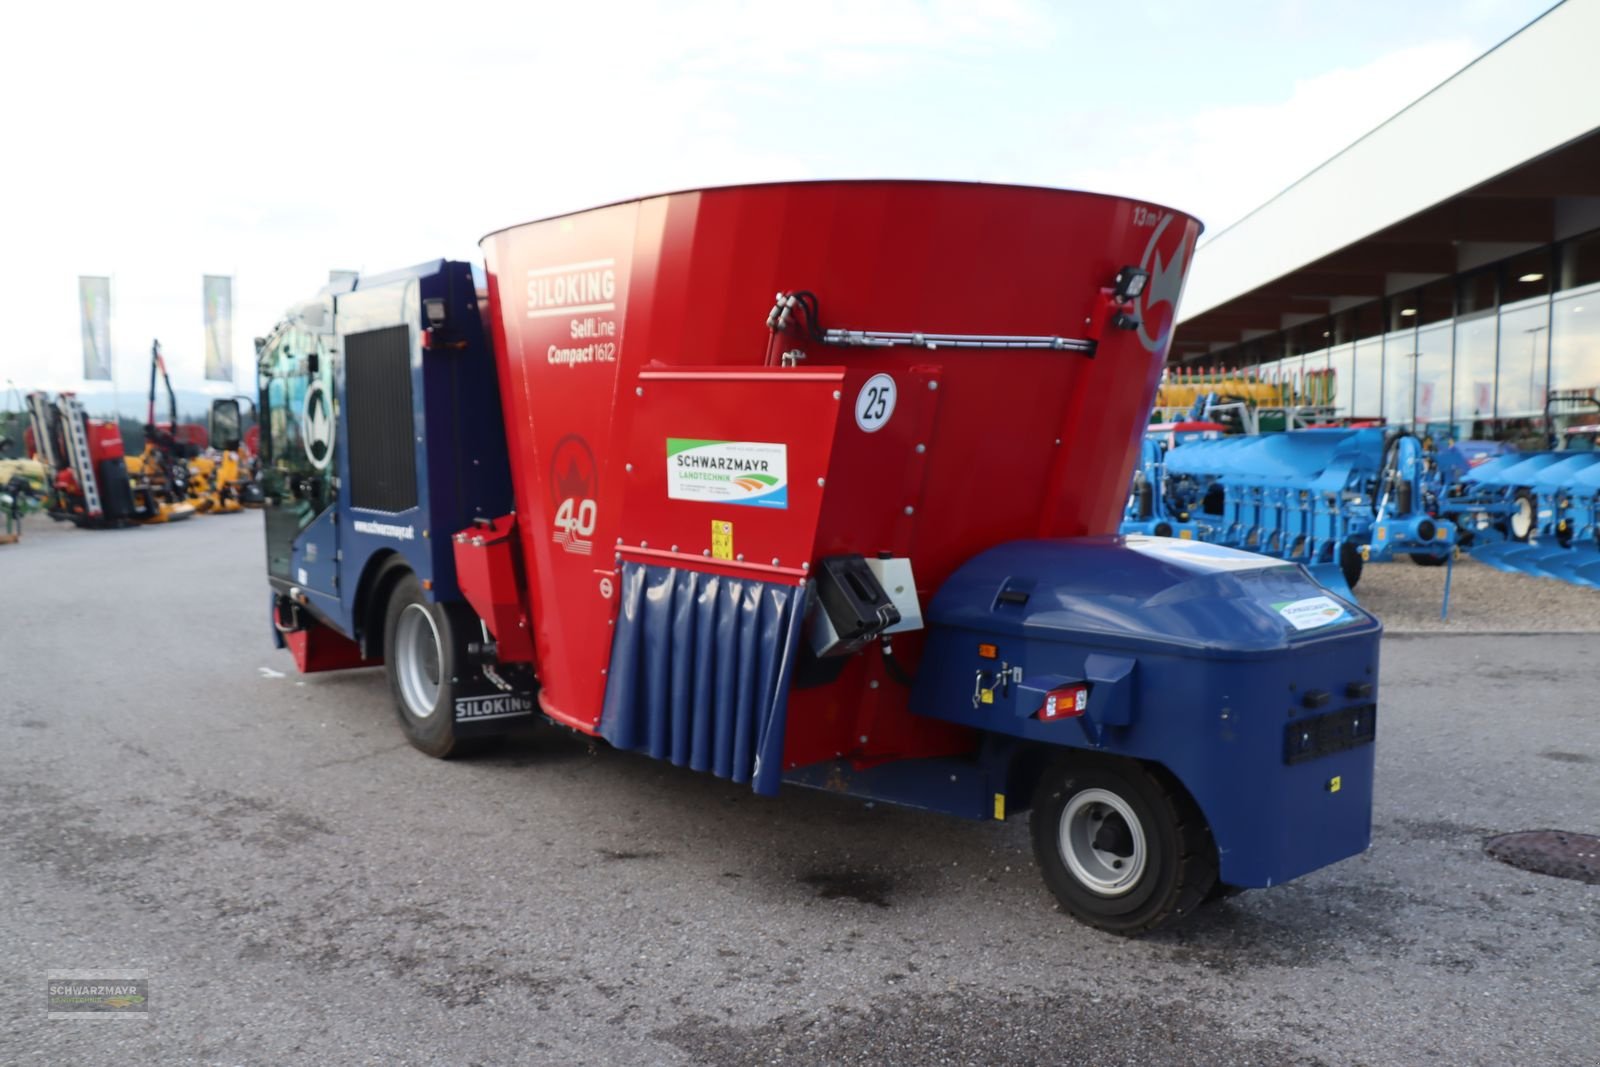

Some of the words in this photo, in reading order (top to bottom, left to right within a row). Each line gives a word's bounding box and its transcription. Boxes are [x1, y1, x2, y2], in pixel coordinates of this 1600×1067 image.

[527, 270, 615, 308] SILOKING
[570, 316, 616, 339] SelfLine
[547, 344, 593, 368] Compact
[594, 342, 616, 363] 1612
[863, 386, 890, 420] 25
[677, 454, 769, 472] SCHWARZMAYR
[679, 470, 731, 482] LANDTECHNIK
[456, 697, 532, 717] SILOKING
